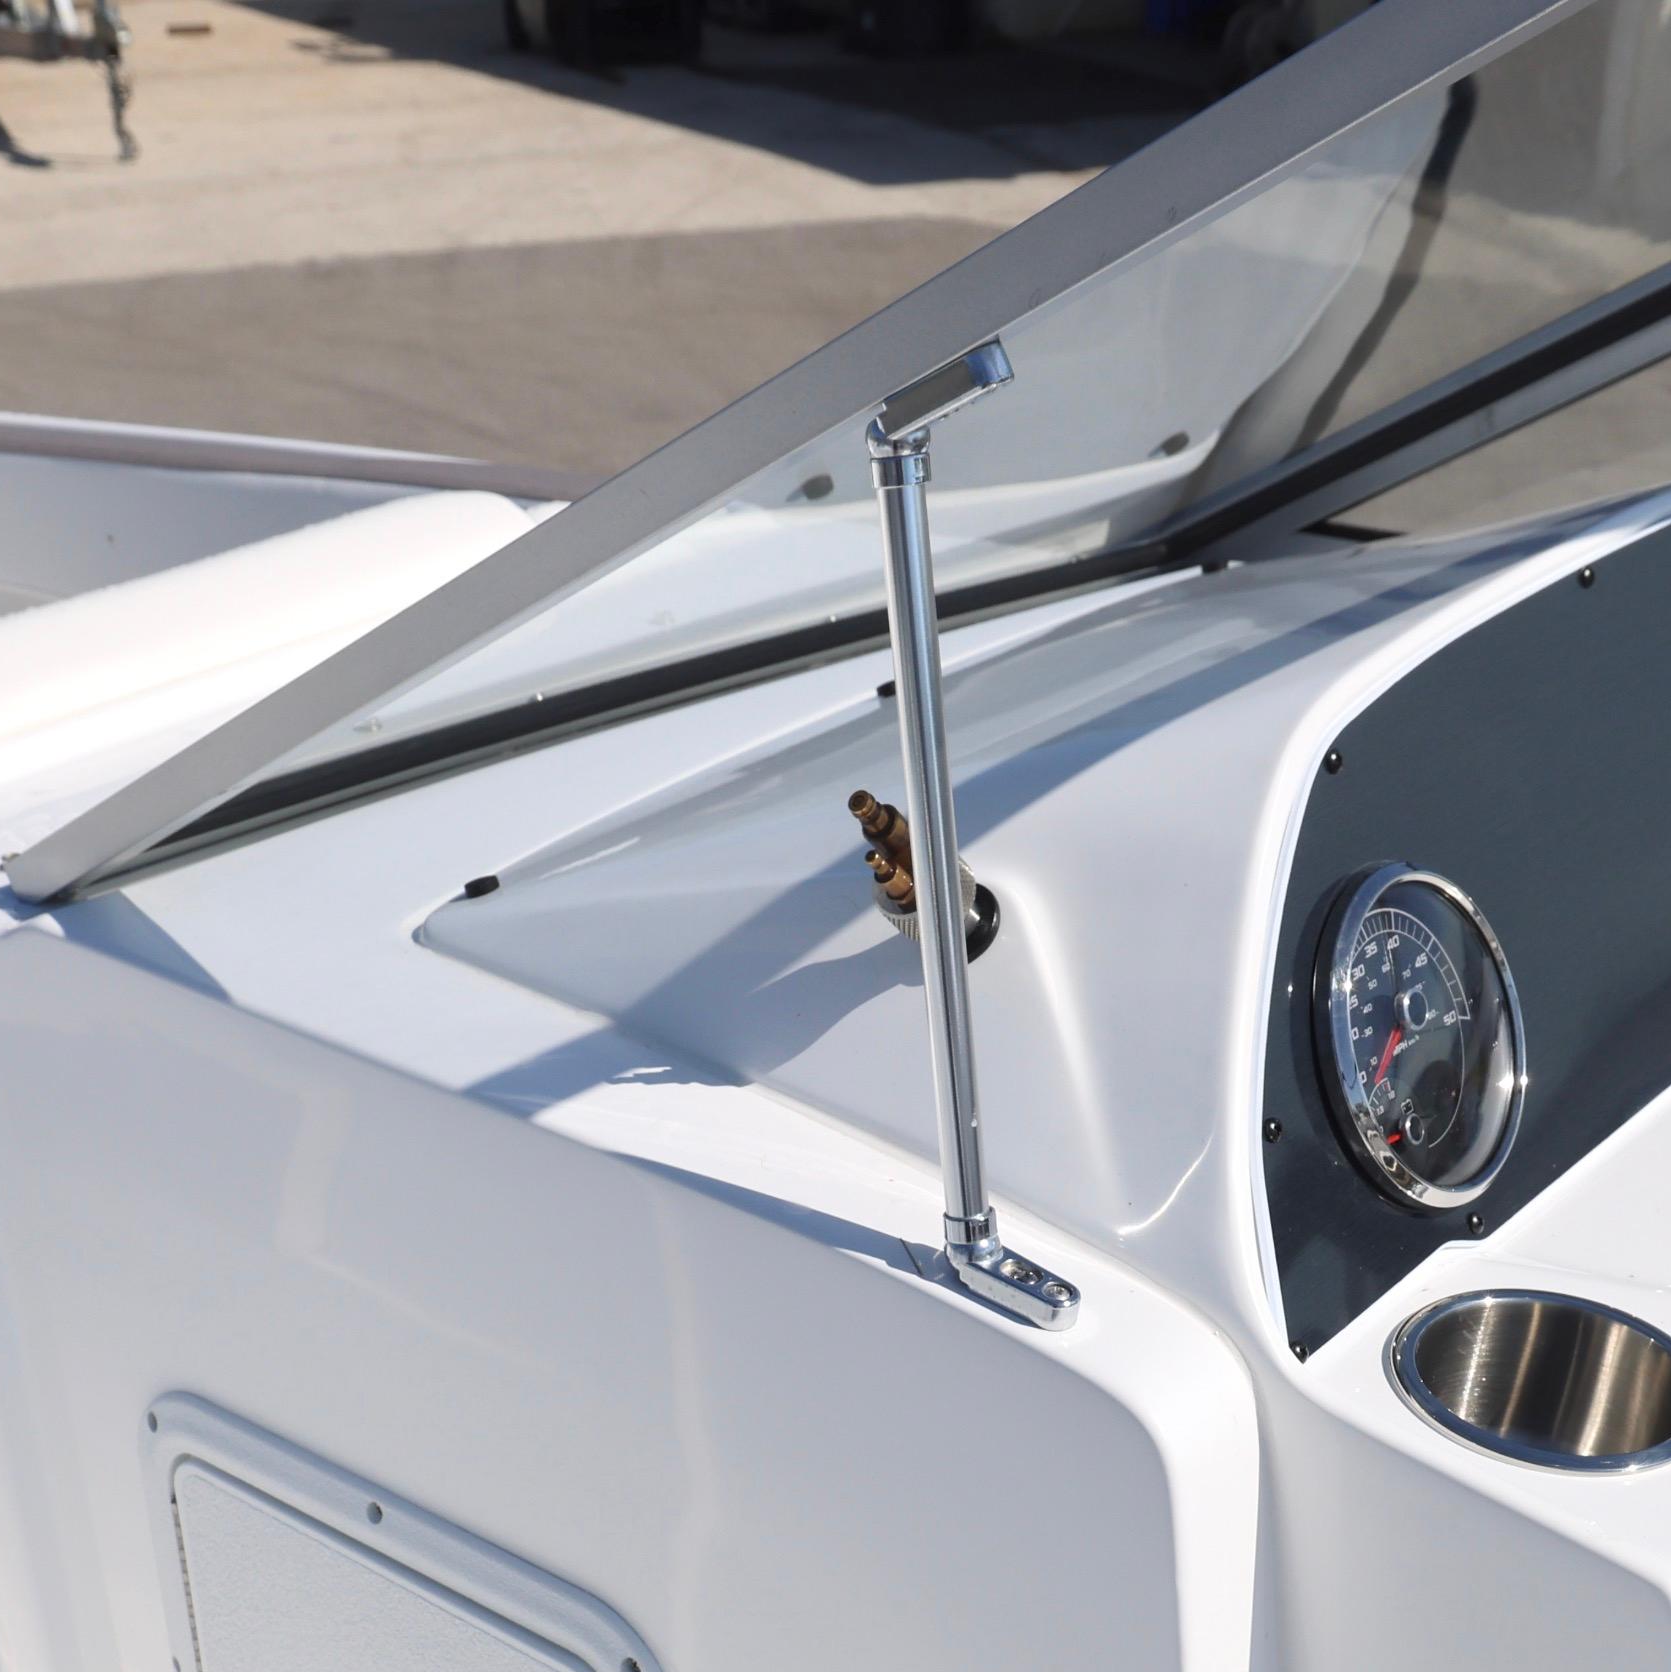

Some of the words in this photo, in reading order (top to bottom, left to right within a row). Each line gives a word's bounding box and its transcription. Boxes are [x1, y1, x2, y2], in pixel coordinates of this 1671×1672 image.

[1364, 941, 1378, 958] 35
[1387, 934, 1400, 950] 40
[1414, 952, 1428, 968] 45
[1351, 964, 1365, 981] 30
[1443, 1010, 1457, 1026] 50
